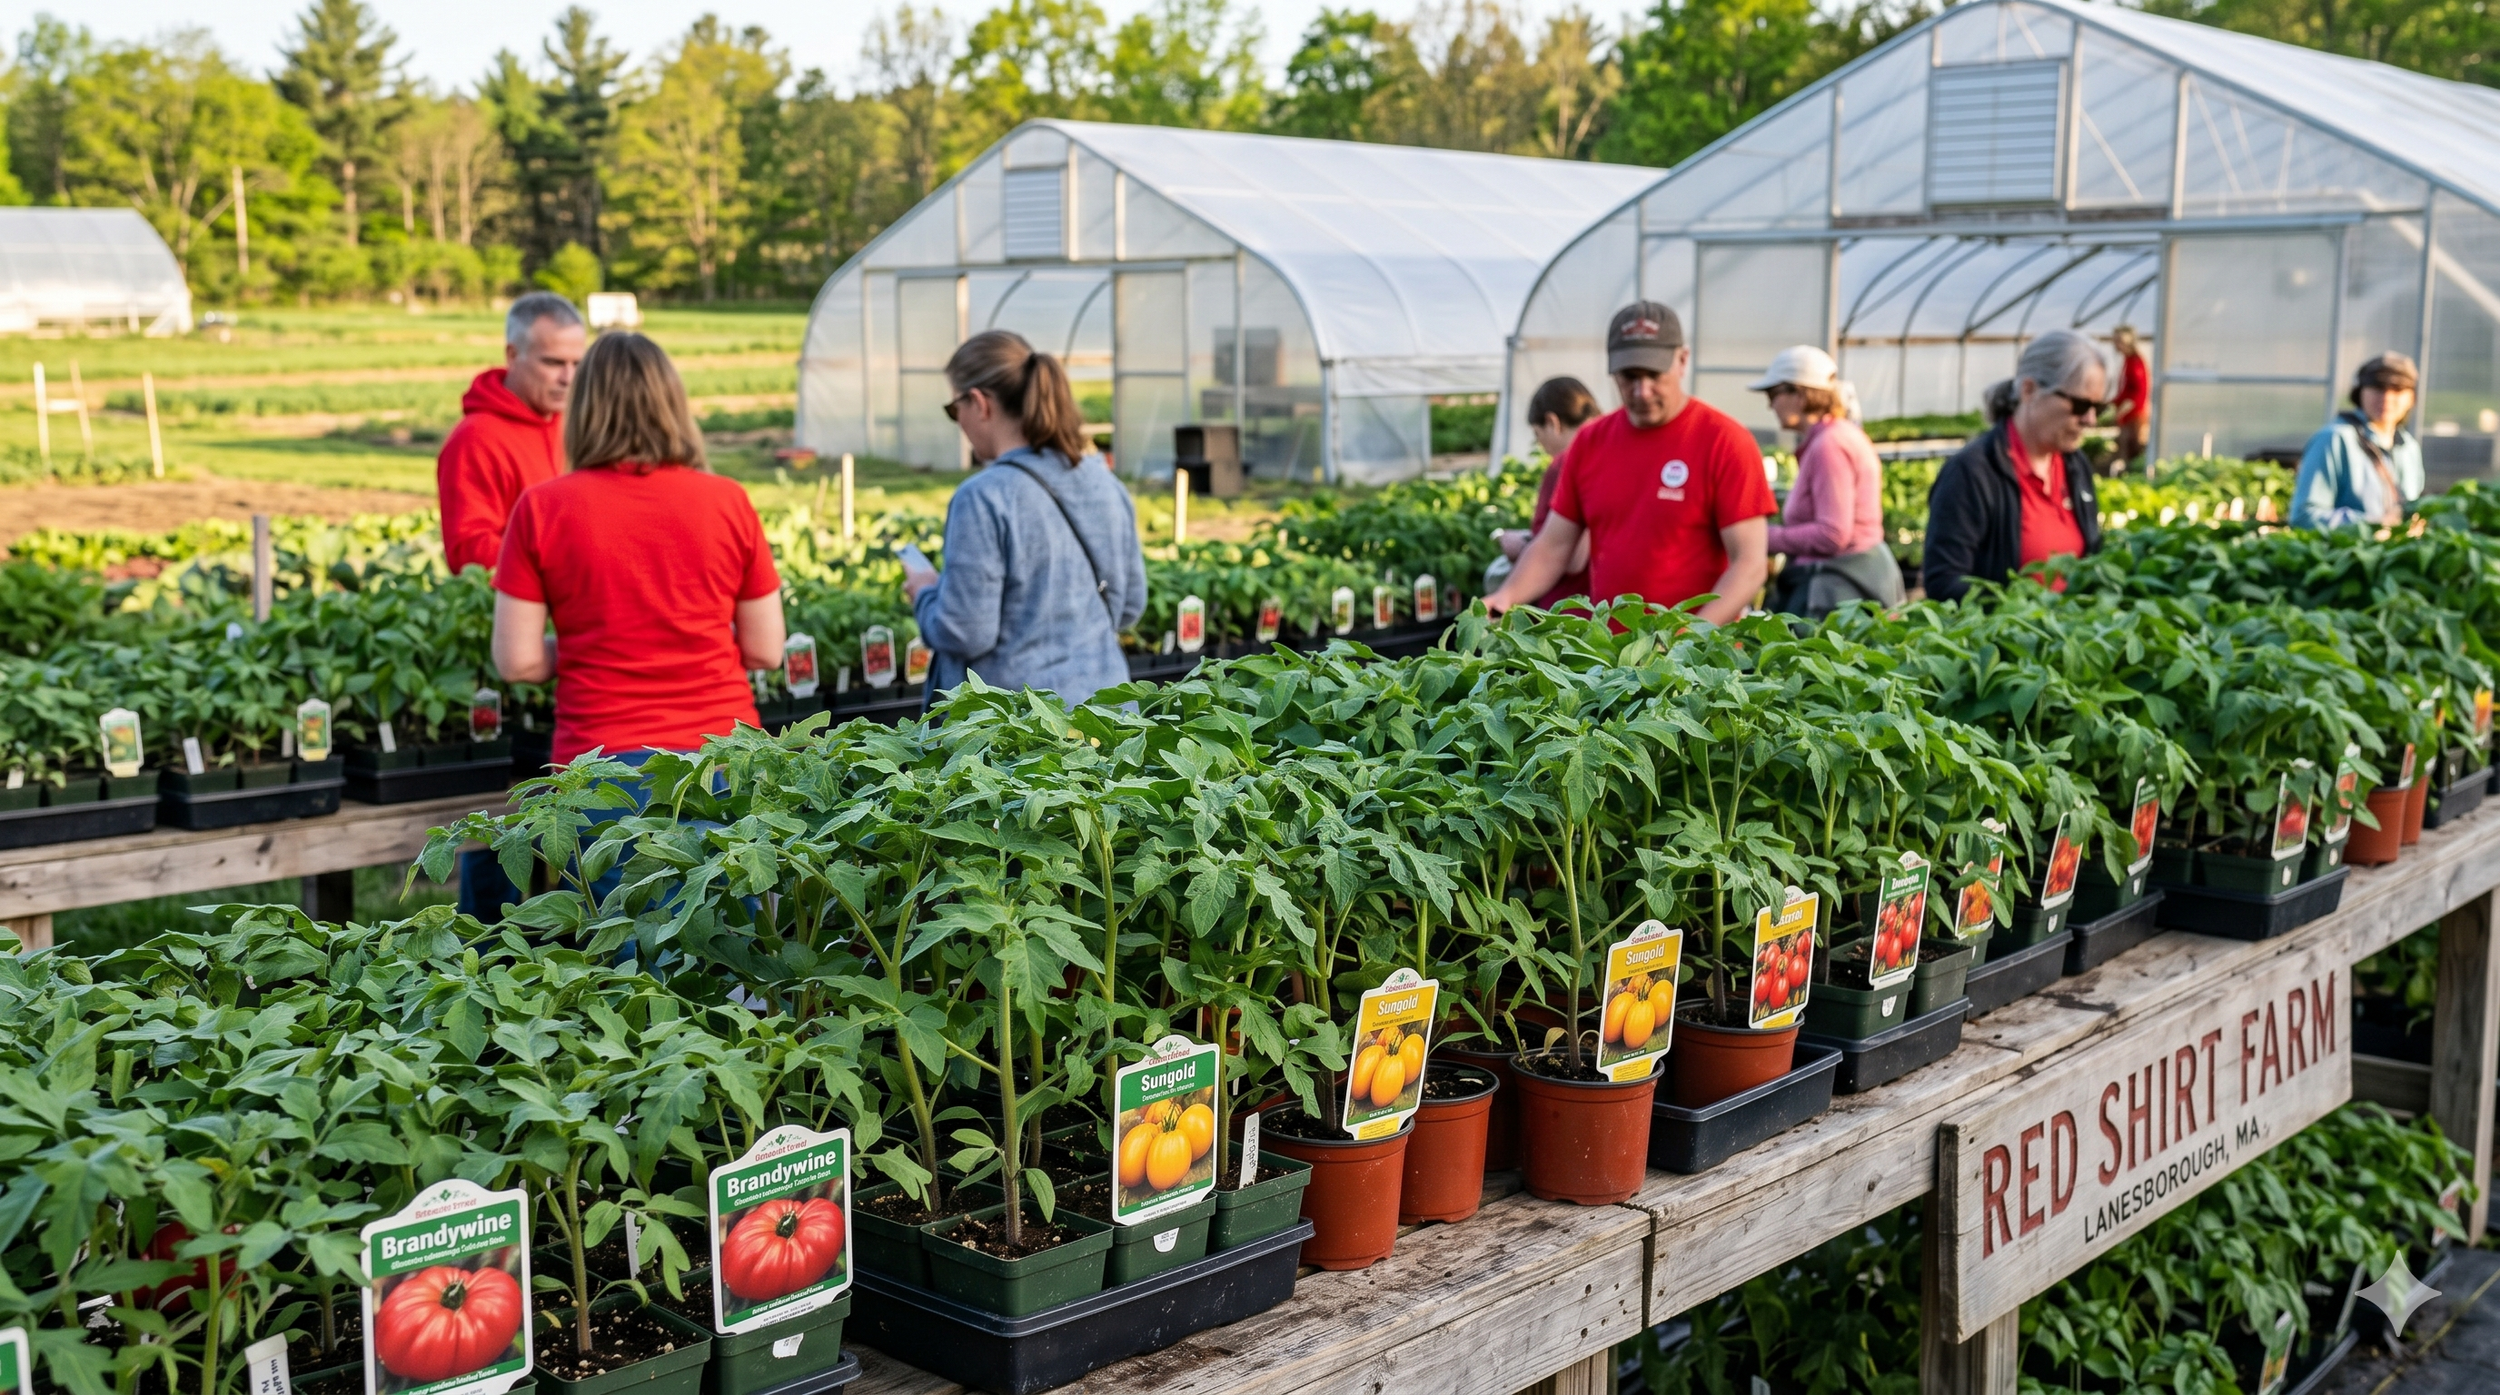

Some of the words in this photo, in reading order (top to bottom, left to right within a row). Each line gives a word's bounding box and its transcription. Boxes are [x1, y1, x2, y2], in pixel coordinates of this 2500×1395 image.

[1625, 942, 1665, 966] Sungold
[1377, 992, 1419, 1016] Sungold
[1141, 1060, 1196, 1092] Sungold
[1983, 1109, 2078, 1260] RED
[2098, 1027, 2222, 1187] SHIRT
[2240, 970, 2336, 1106] FARM
[727, 1150, 836, 1198] Brandywine
[2084, 1134, 2230, 1244] LANESBOROUGH,
[381, 1213, 512, 1260] Brandywine
